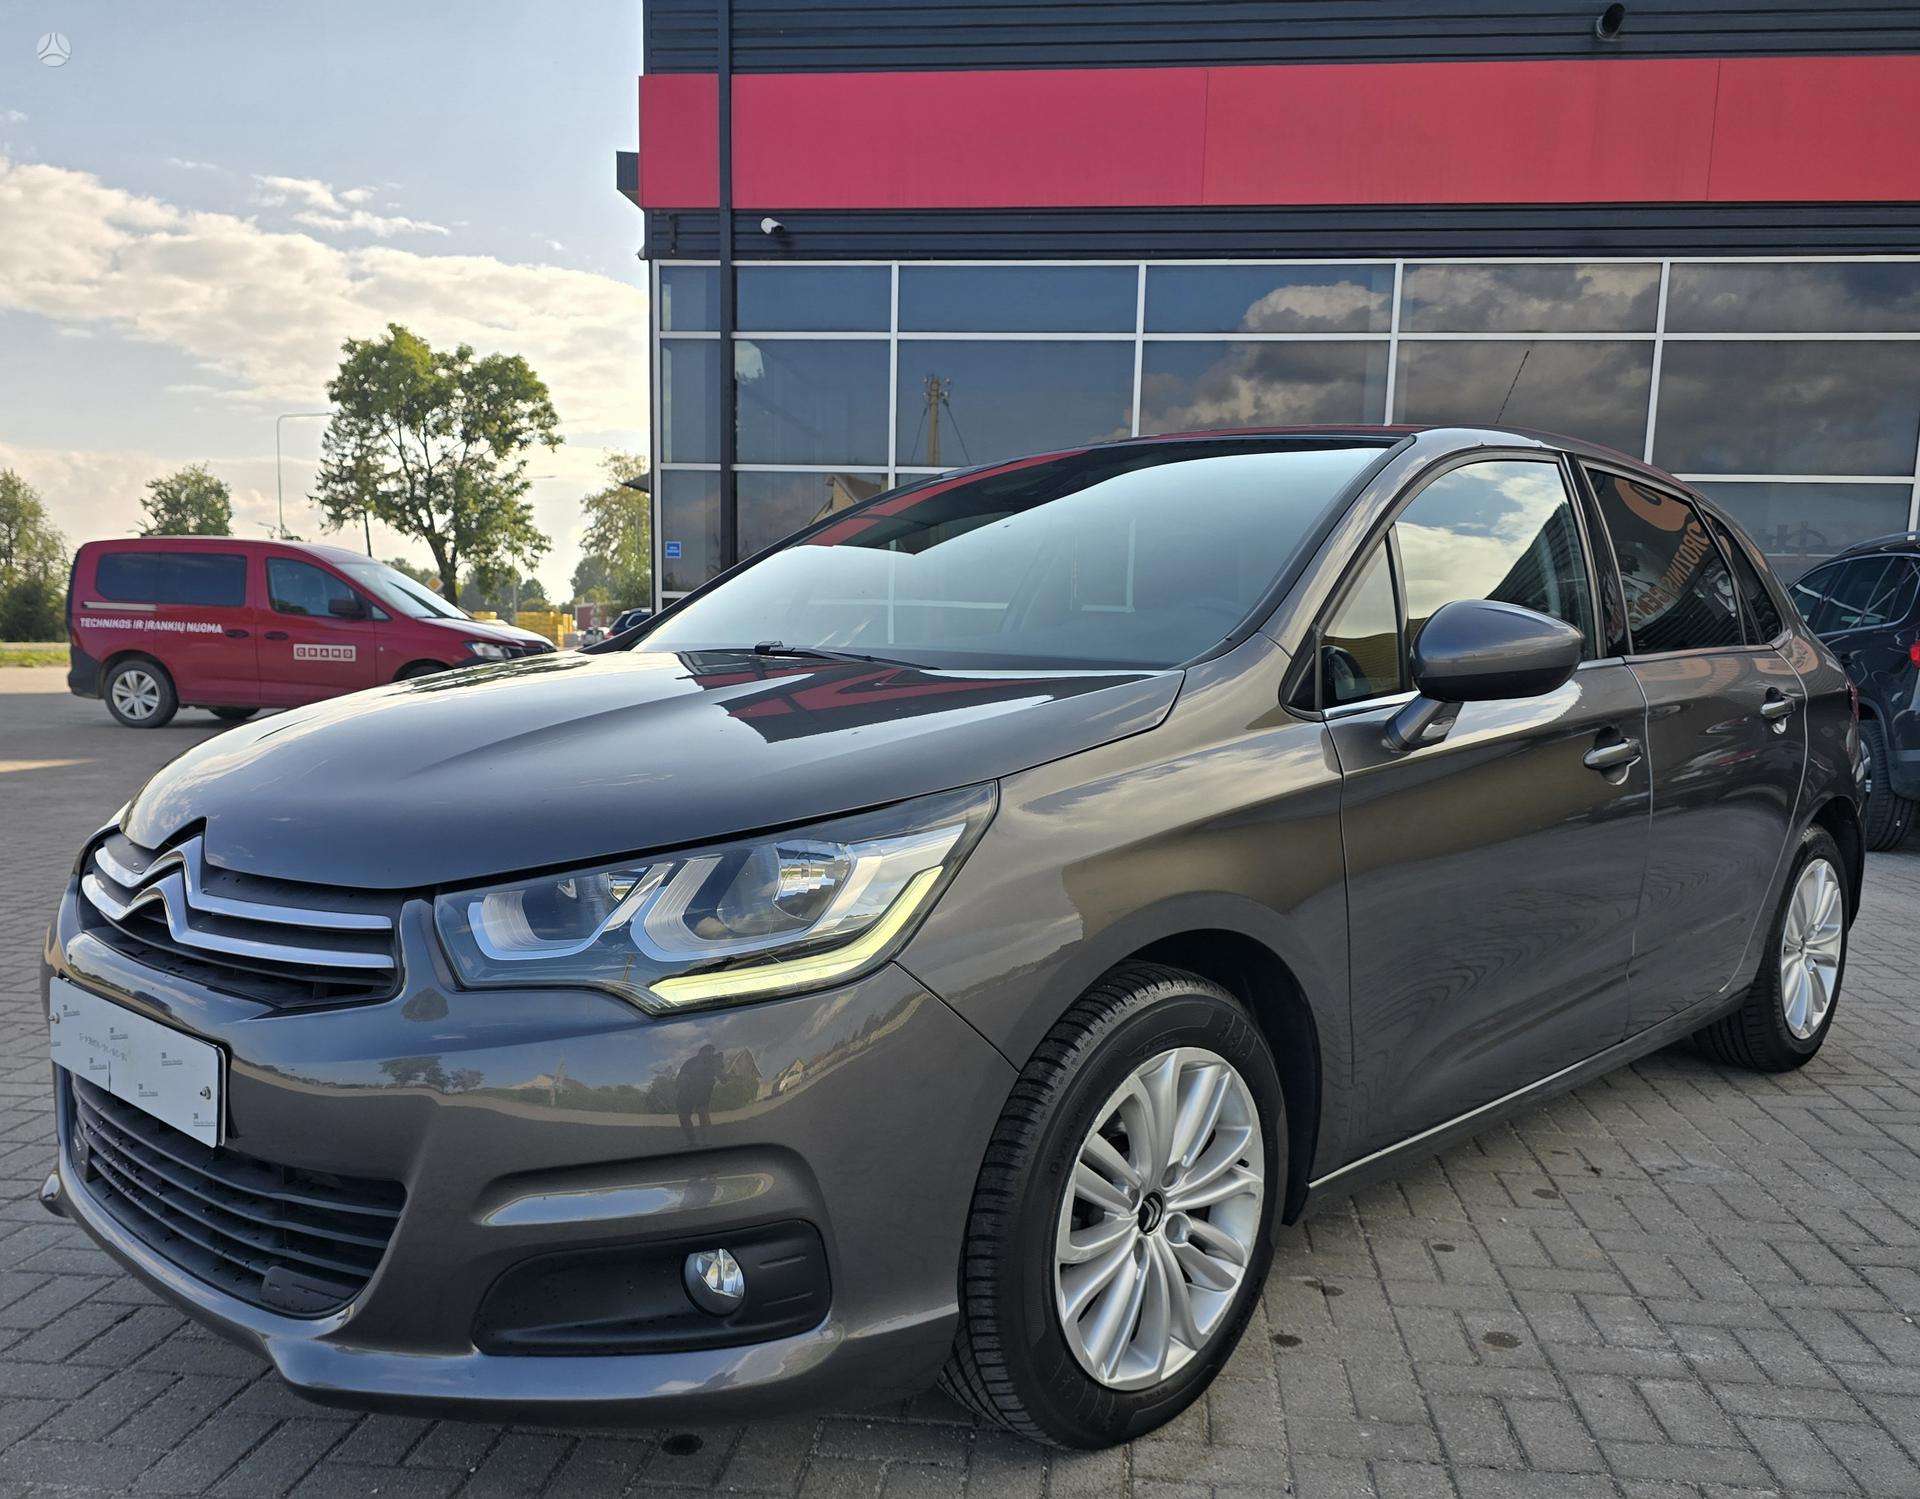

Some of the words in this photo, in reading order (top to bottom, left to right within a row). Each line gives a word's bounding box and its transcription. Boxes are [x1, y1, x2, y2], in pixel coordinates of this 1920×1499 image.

[80, 618, 132, 629] TECHNIKOS
[133, 620, 144, 629] IR
[187, 622, 224, 633] NUOMA
